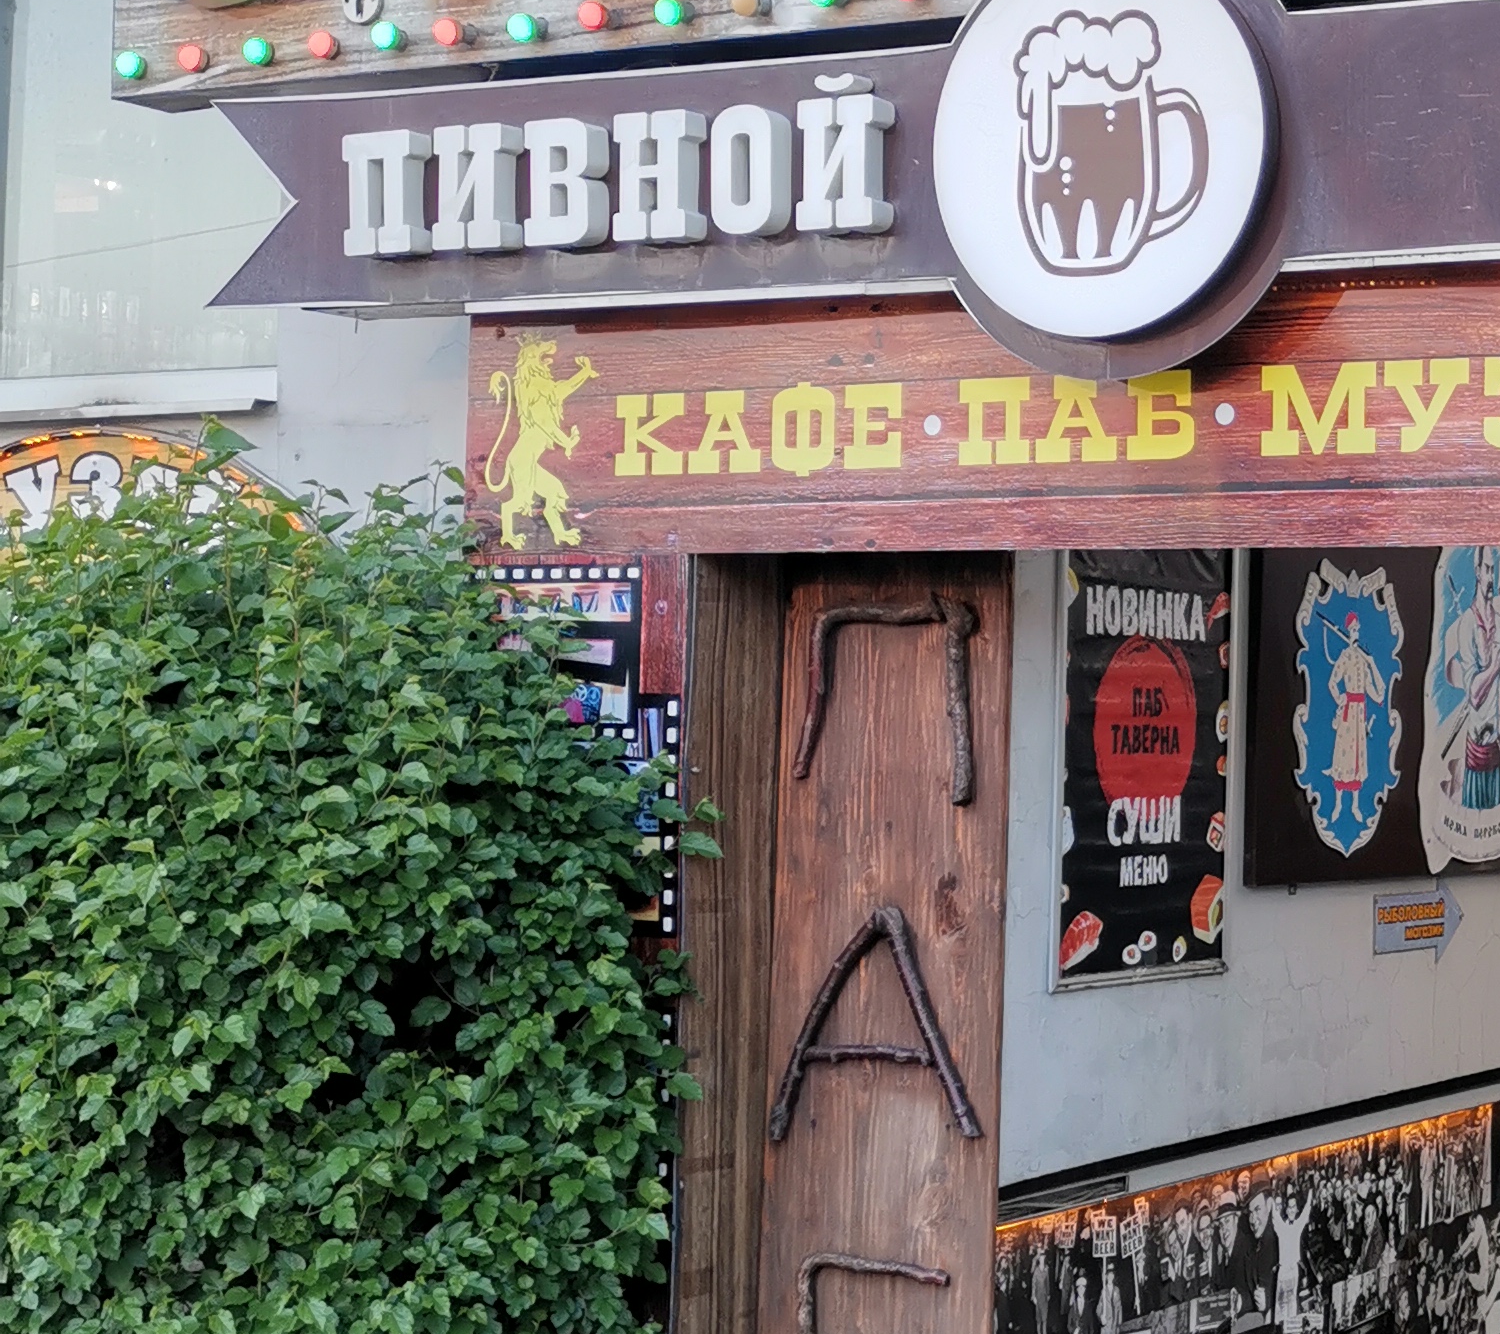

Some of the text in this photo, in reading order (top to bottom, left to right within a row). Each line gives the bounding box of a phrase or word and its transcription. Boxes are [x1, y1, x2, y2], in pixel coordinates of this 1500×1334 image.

[342, 72, 895, 256] ПИВНОЙ
[614, 381, 902, 476] КАФЕ
[959, 369, 1194, 465] ПАБ
[1086, 585, 1206, 642] НОВИНКА
[1132, 686, 1164, 718] ПАБ
[1111, 724, 1180, 755] ТАВЕРНА
[1107, 795, 1182, 847] СУШИ
[1119, 854, 1169, 887] МЕНЮ
[1377, 897, 1445, 925] РЫБОЛОВНЫЙ
[1094, 1242, 1115, 1255] BEER
